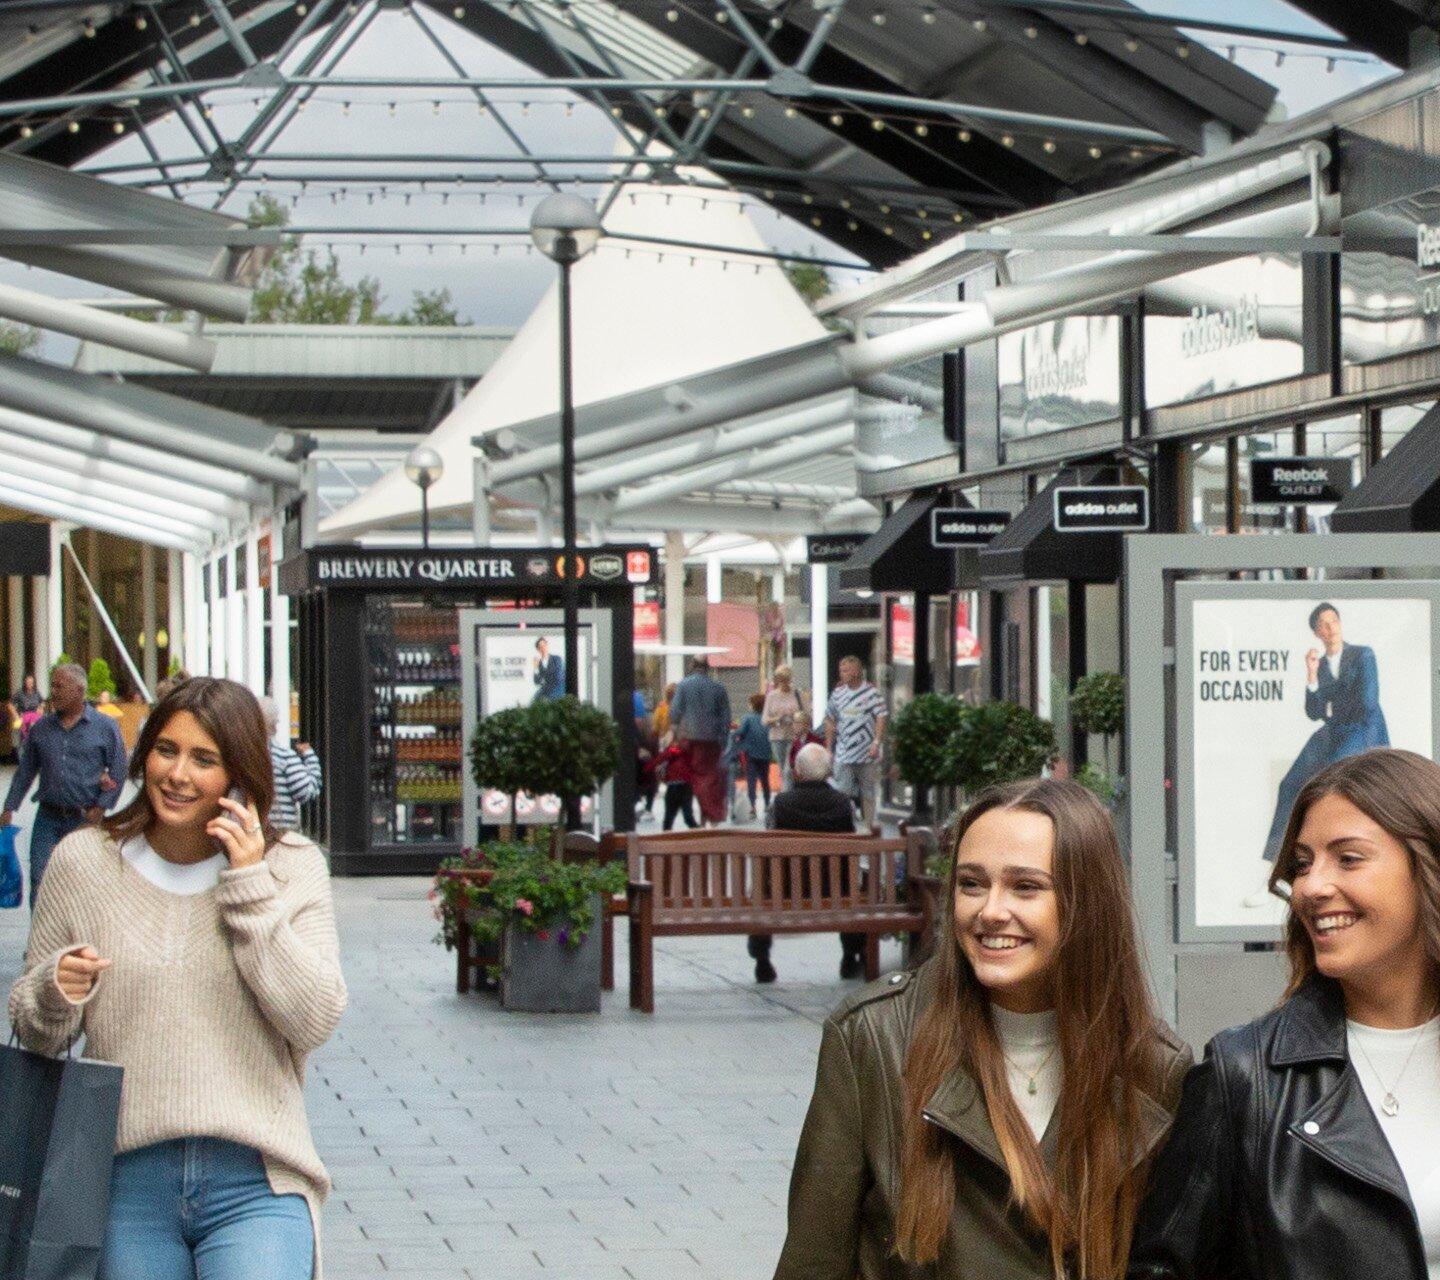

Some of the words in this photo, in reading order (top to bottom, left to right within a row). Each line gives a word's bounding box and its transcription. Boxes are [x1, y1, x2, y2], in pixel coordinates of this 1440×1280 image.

[1273, 467, 1328, 483] Reebok
[1064, 502, 1105, 516] adidas
[1106, 502, 1138, 516] outlet
[941, 523, 977, 534] adidas
[317, 558, 415, 579] BREWERY
[417, 558, 516, 582] QUARTER
[1199, 649, 1232, 672] FOR
[1238, 649, 1290, 672] EVERY
[1199, 679, 1284, 702] OCCASION
